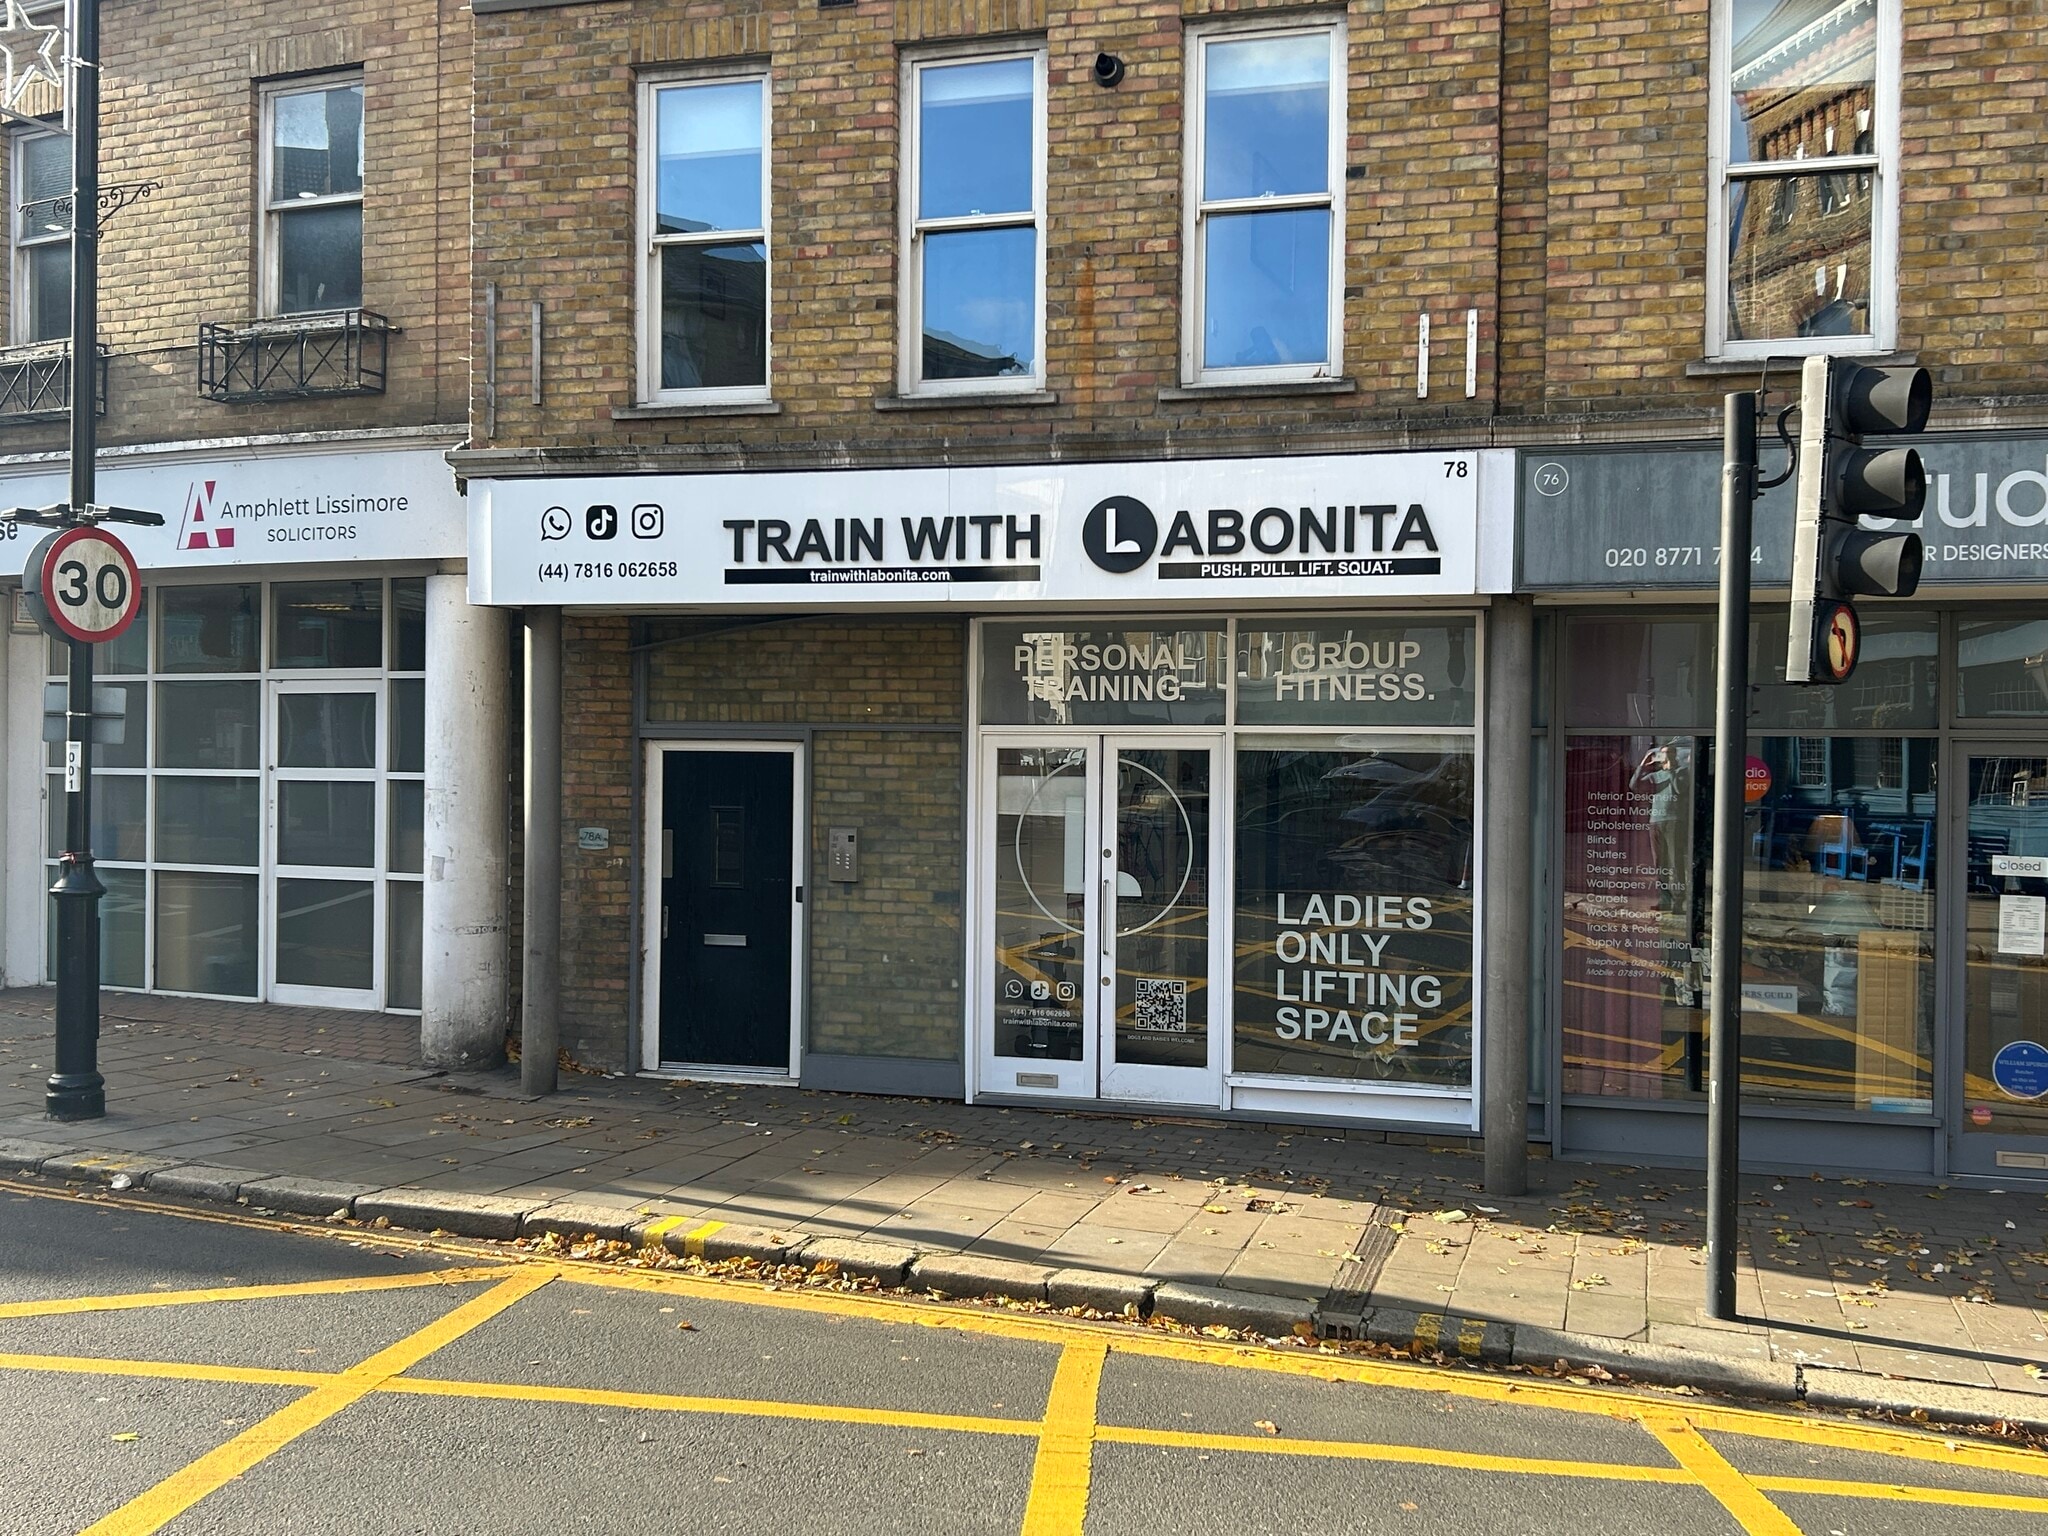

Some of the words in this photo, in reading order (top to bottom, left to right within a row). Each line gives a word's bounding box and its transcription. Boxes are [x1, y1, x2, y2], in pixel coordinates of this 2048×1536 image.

[1443, 461, 1468, 478] 78
[1543, 473, 1560, 486] 76
[220, 497, 310, 522] Amphlett
[316, 494, 409, 514] Lissimore
[266, 526, 357, 543] SOLICITORS
[722, 518, 884, 562] TRAIN
[900, 514, 1041, 561] WITH
[1605, 547, 1648, 568] 020
[1654, 546, 1702, 566] 8771
[538, 562, 569, 582] (44)
[574, 562, 613, 578] 7816
[618, 561, 678, 578] 062658
[809, 568, 951, 582] trainwithlabonita.com
[1200, 563, 1247, 577] PUSH.
[1250, 562, 1295, 577] PULL.
[1299, 561, 1335, 576] LIFT.
[1337, 560, 1395, 575] SQUAT.
[58, 560, 127, 609] 30
[1014, 644, 1197, 671] PERSONAL
[1290, 641, 1421, 670] GROUP
[1021, 675, 1186, 702] TRAINING.
[1276, 673, 1435, 701] FITNESS.
[1587, 791, 1623, 801] Interior
[1626, 791, 1678, 804] Designers
[1587, 805, 1626, 816] Curtain
[1628, 806, 1667, 817] Makers
[1587, 820, 1651, 831] Upholsterers
[1587, 834, 1617, 845] Blinds
[1586, 849, 1627, 859] Shutters
[1586, 863, 1633, 875] Designer
[1635, 865, 1674, 876] Fabrics
[1998, 860, 2042, 872] closed
[1586, 878, 1646, 891] Wallpapers
[1655, 880, 1686, 891] Paints
[1586, 892, 1629, 904] Carpets
[1276, 893, 1434, 931] LADIES
[1586, 907, 1617, 917] Wood
[1586, 922, 1618, 933] Tracks
[1620, 923, 1630, 933] &
[1631, 923, 1660, 934] Poles
[1275, 930, 1391, 967] ONLY
[1586, 937, 1622, 950] Supply
[1624, 938, 1633, 948] &
[1635, 938, 1693, 950] Installation
[1276, 968, 1443, 1009] LIFTING
[1764, 991, 1793, 1000] GUILD
[1275, 1006, 1419, 1047] SPACE
